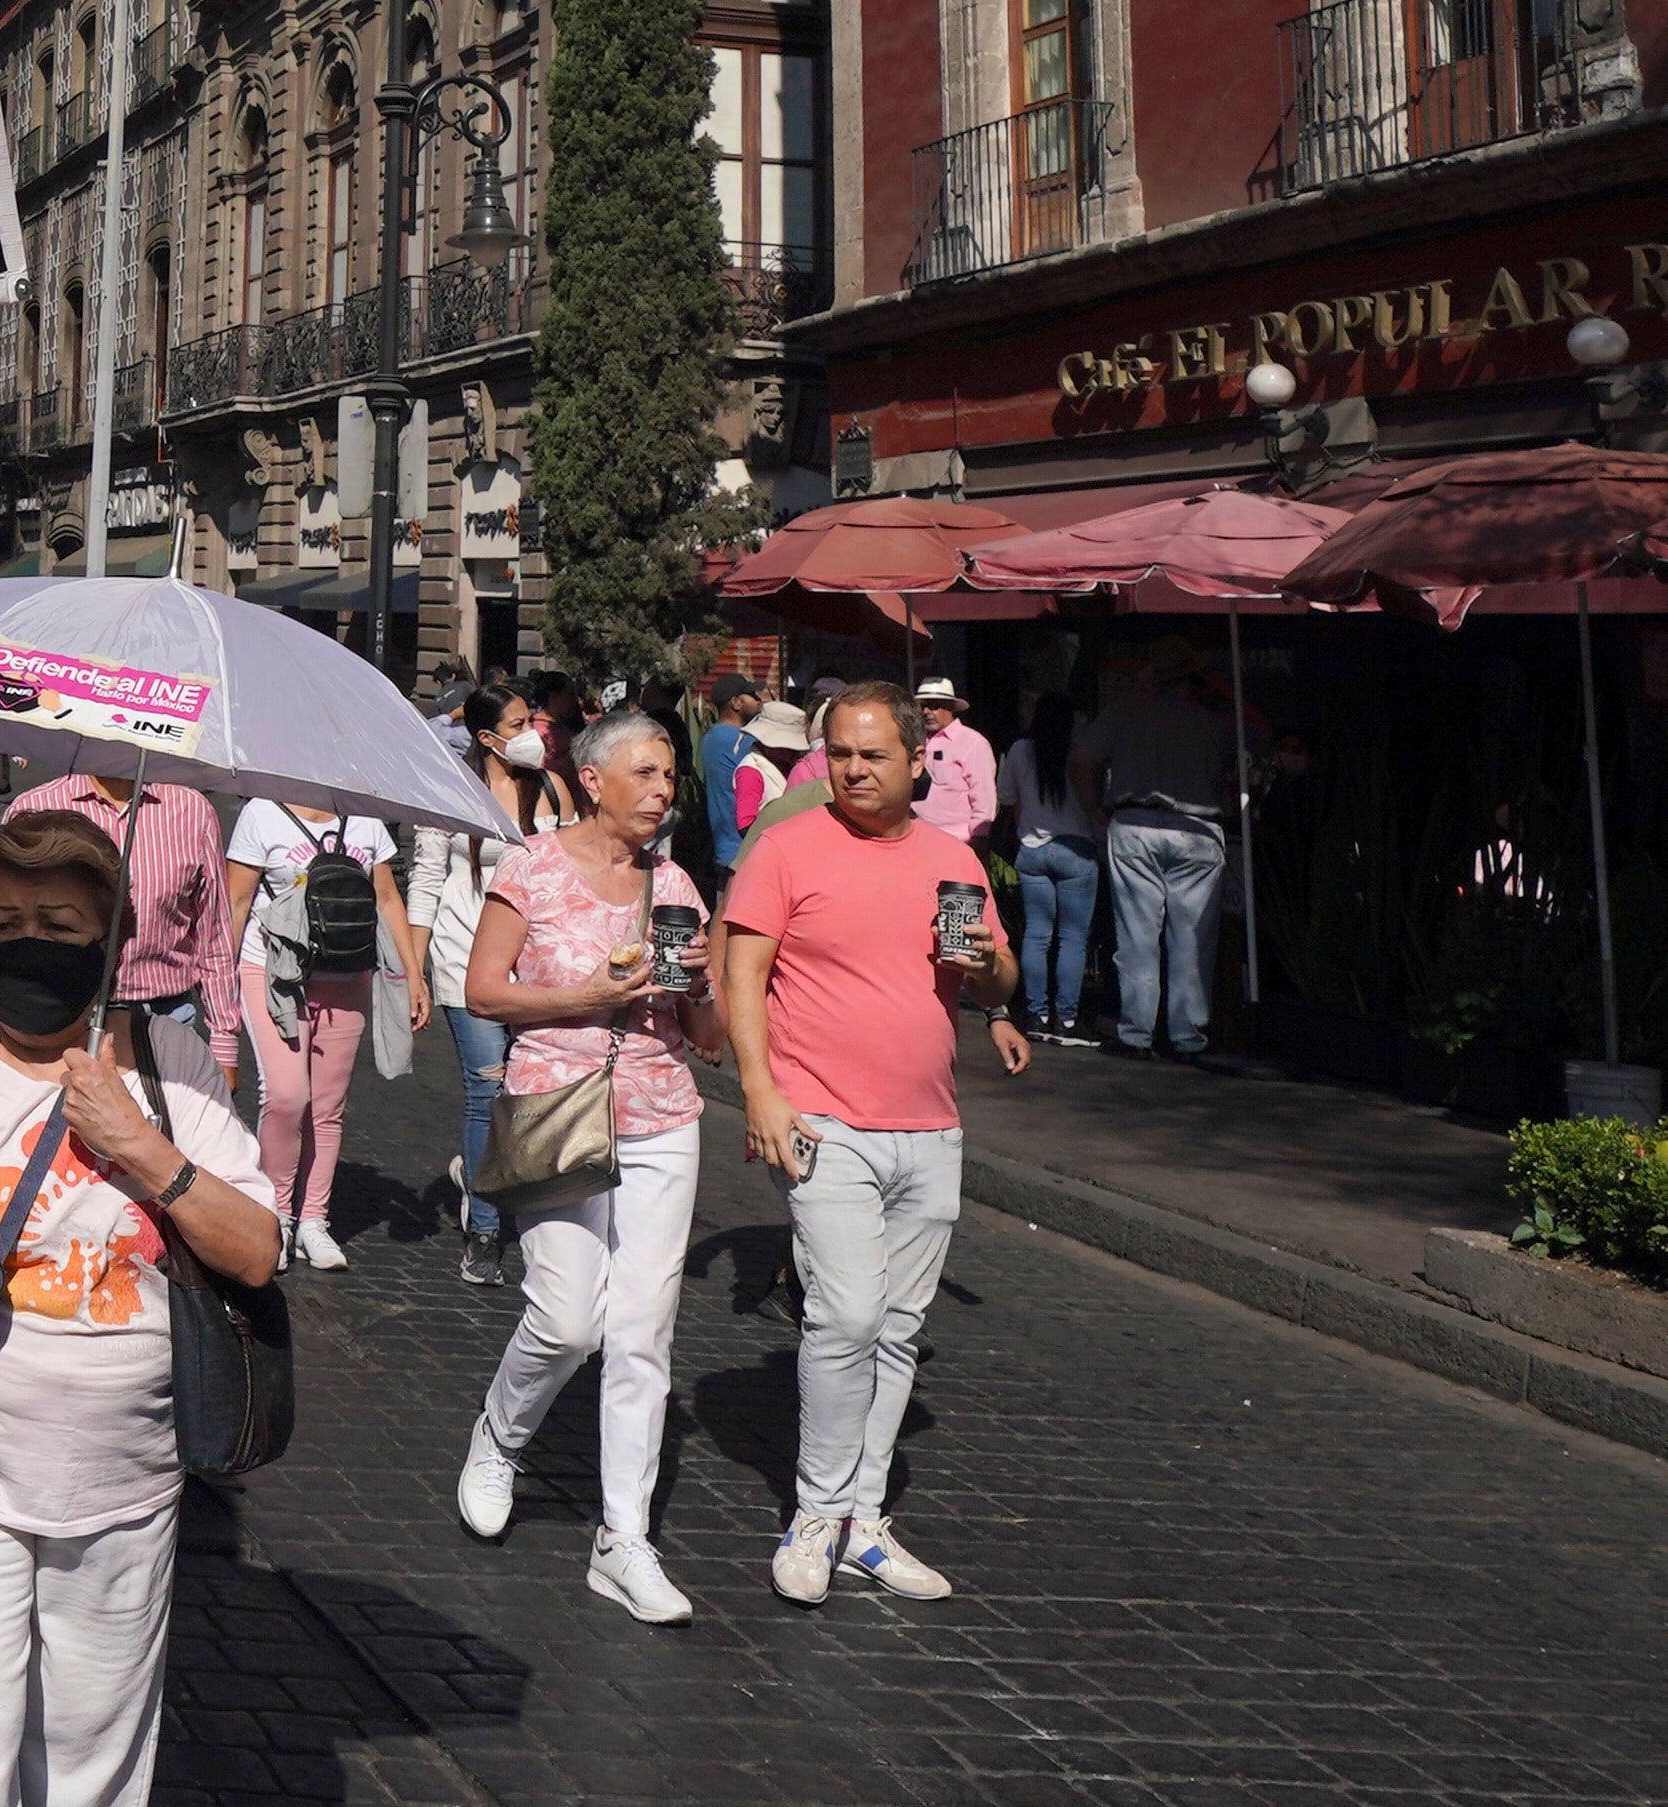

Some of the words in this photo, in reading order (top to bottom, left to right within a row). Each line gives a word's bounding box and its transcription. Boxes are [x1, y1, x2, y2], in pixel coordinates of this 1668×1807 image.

[1058, 333, 1155, 396] Café
[1167, 323, 1231, 381] EL
[1251, 257, 1600, 364] POPULAR
[91, 687, 125, 700] Hazlo
[126, 694, 149, 706] por
[150, 696, 195, 713] México
[116, 677, 145, 695] al
[148, 679, 203, 705] INE
[133, 720, 185, 738] INE
